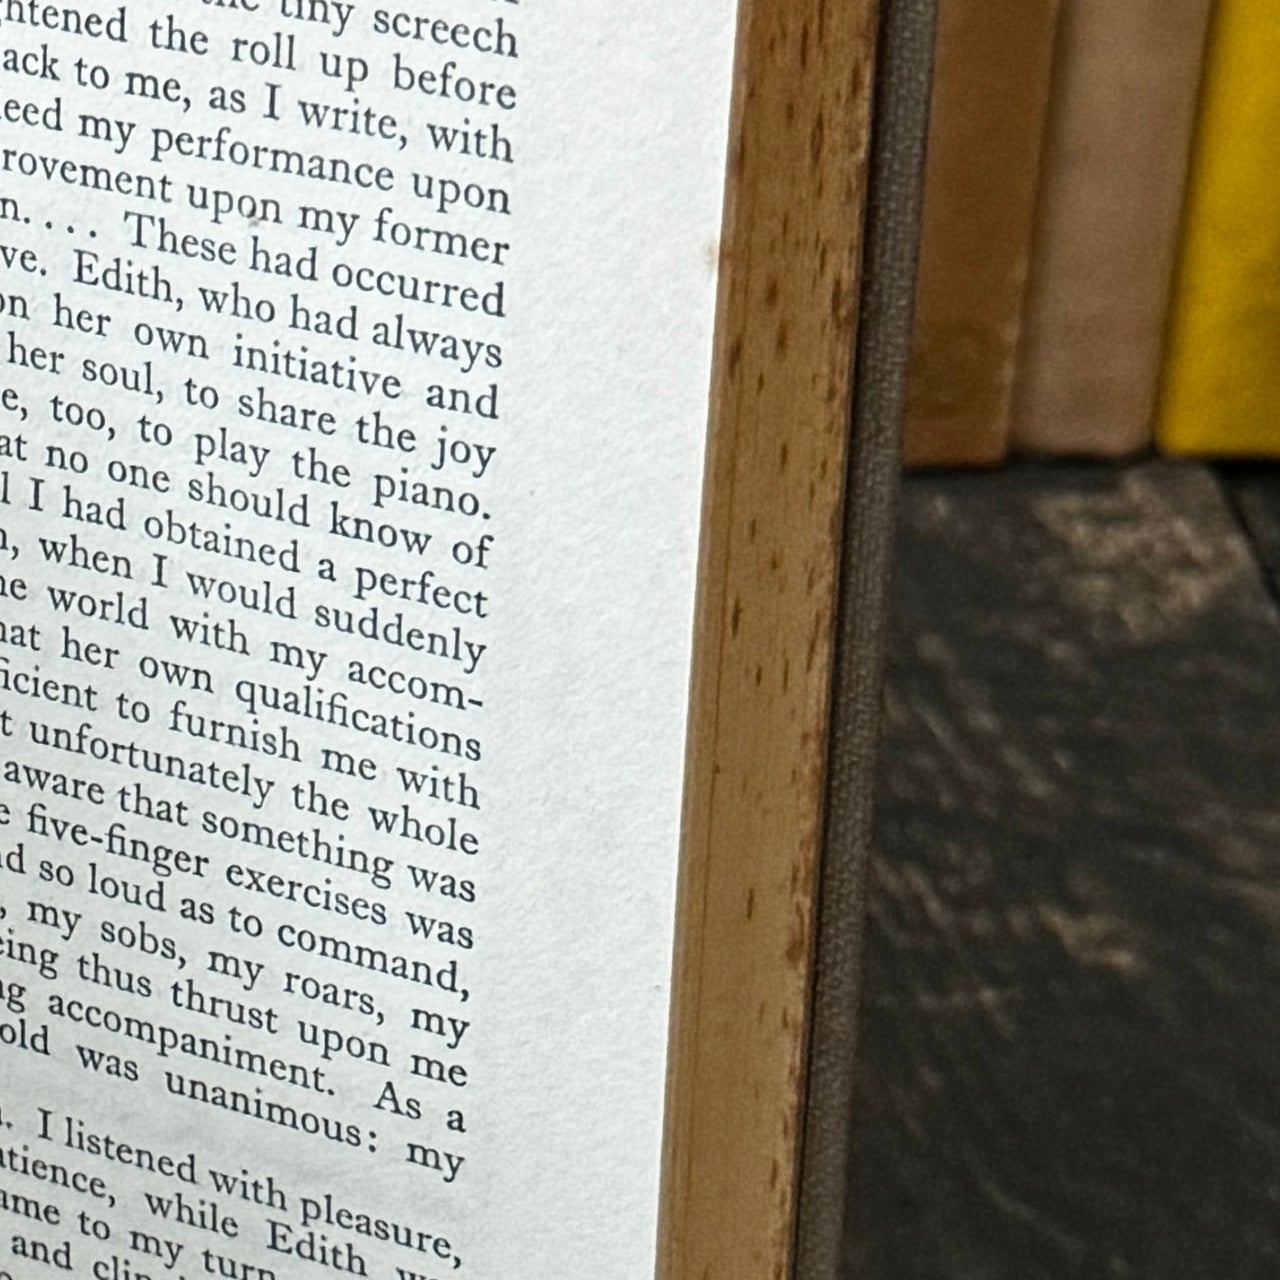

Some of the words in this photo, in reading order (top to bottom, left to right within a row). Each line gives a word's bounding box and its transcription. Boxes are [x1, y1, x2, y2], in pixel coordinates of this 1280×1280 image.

[186, 183, 283, 225] upon
[297, 206, 361, 247] my
[372, 206, 510, 266] former
[60, 625, 120, 670] her
[138, 656, 214, 694] own
[235, 680, 482, 762] qualifications
[75, 1044, 139, 1082] was
[164, 1071, 377, 1153] unanimous:
[405, 1142, 466, 1184] my
[11, 1235, 74, 1271] and
